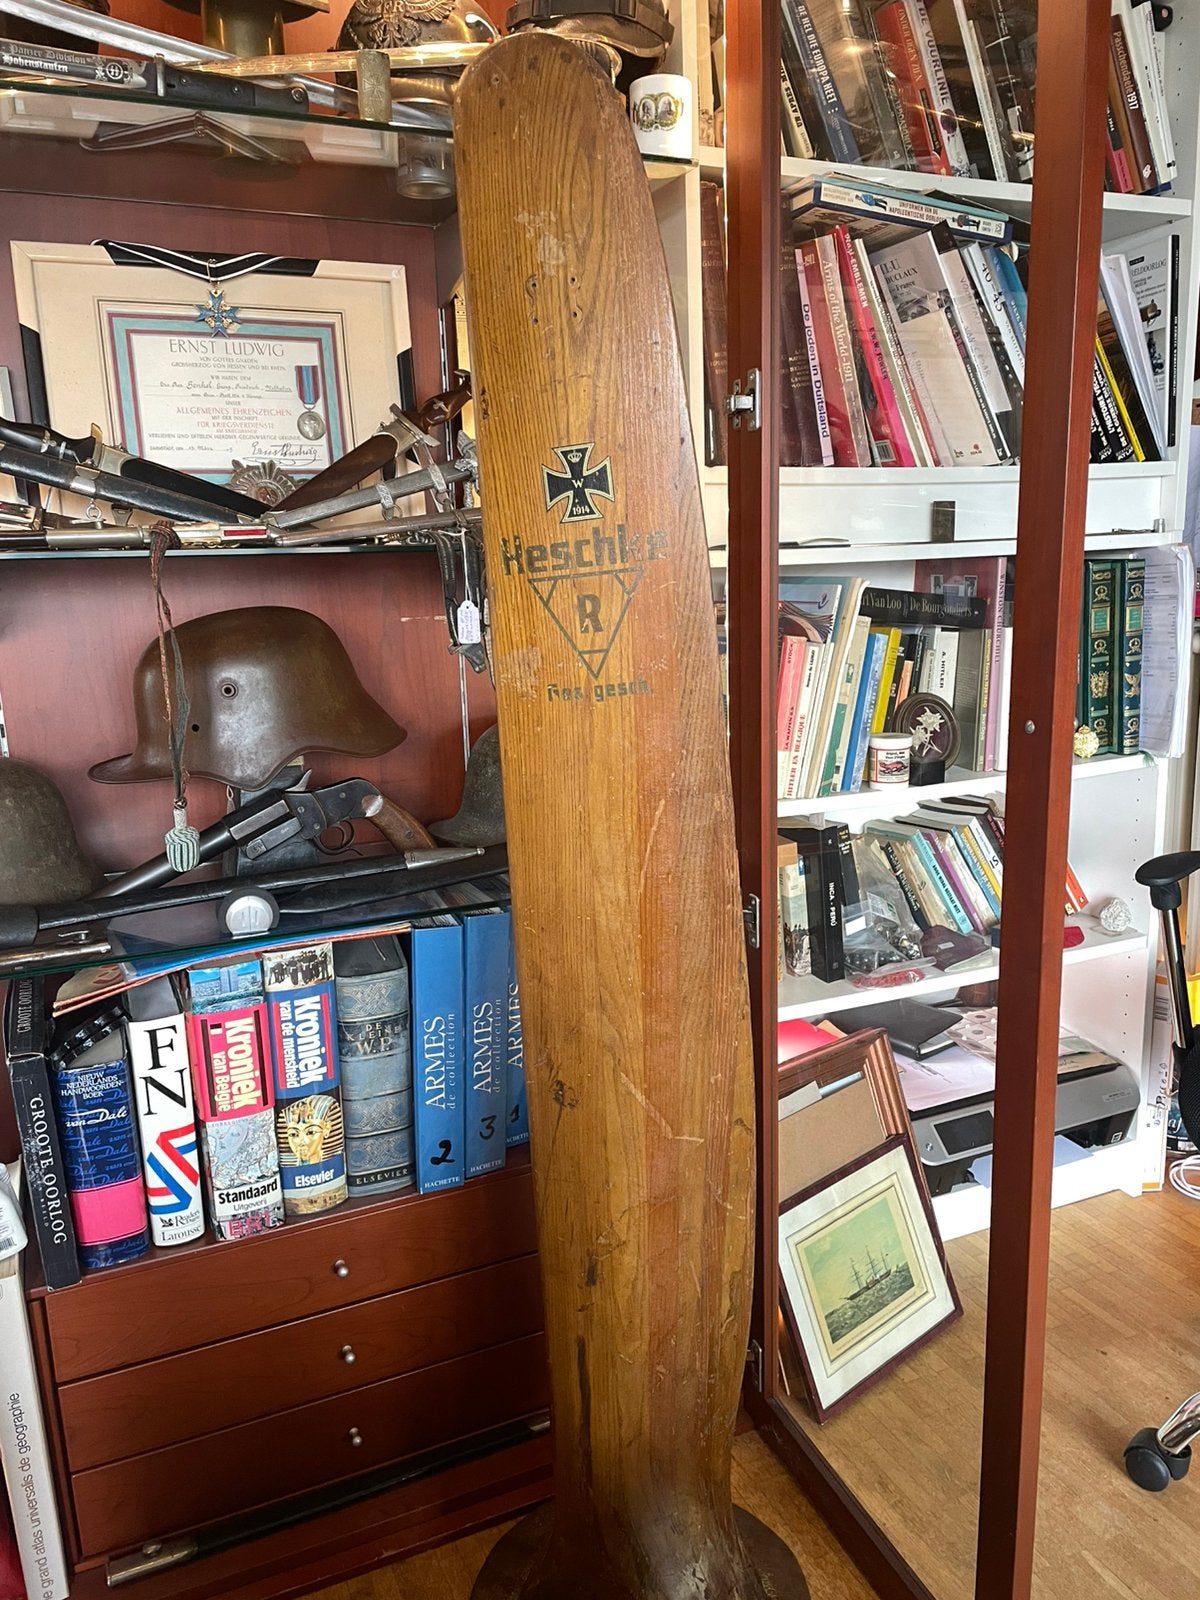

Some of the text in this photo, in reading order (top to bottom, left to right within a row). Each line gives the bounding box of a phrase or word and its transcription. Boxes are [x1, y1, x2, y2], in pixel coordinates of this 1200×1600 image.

[46, 50, 87, 65] Division
[798, 5, 838, 103] DE HEL DIE EUROPA HEET
[925, 31, 950, 106] VUURLINIE
[1113, 31, 1139, 110] Passchendaele 1917
[822, 259, 834, 292] Arms
[169, 338, 285, 358] ERNST LUDWIG
[811, 364, 819, 377] in
[176, 406, 292, 416] ALLGEMEINES EHRENZEICHEN
[813, 379, 831, 438] Duitsland
[572, 478, 584, 489] W
[572, 506, 590, 515] 1914
[577, 593, 604, 634] R
[887, 594, 902, 609] Loo
[910, 598, 920, 611] De
[794, 714, 806, 753] BELGIQUE
[828, 882, 836, 901] INCA
[345, 1025, 401, 1042] KLEINE
[365, 1022, 382, 1032] DE
[494, 998, 503, 1072] collection
[144, 1024, 178, 1070] F
[279, 1000, 301, 1089] van de mensheid
[293, 994, 328, 1087] Kroniek
[355, 1037, 393, 1055] W.P.
[473, 1001, 494, 1095] ARMES
[225, 1016, 259, 1110] Kroniek
[423, 1015, 446, 1110] ARMES
[446, 1012, 456, 1109] de collection
[61, 1080, 125, 1097] HANDWOORDEN-
[67, 1074, 119, 1090] NEDERLANDS
[77, 1071, 105, 1082] NIEUW
[213, 1051, 232, 1113] van België
[83, 1092, 104, 1100] BOEK
[139, 1067, 188, 1116] N
[510, 1104, 520, 1123] 1
[478, 1115, 497, 1140] 3
[430, 1139, 455, 1166] 2
[294, 1167, 335, 1188] Elsevier
[356, 1168, 409, 1185] ELSEVIER
[470, 1160, 503, 1174] HACHETTE
[217, 1178, 278, 1204] Standaard
[424, 1176, 461, 1189] HACHETTE
[43, 1171, 67, 1244] OORLOG
[161, 1224, 201, 1241] Larousse
[9, 1392, 54, 1590] grand atlas universalis de géographie
